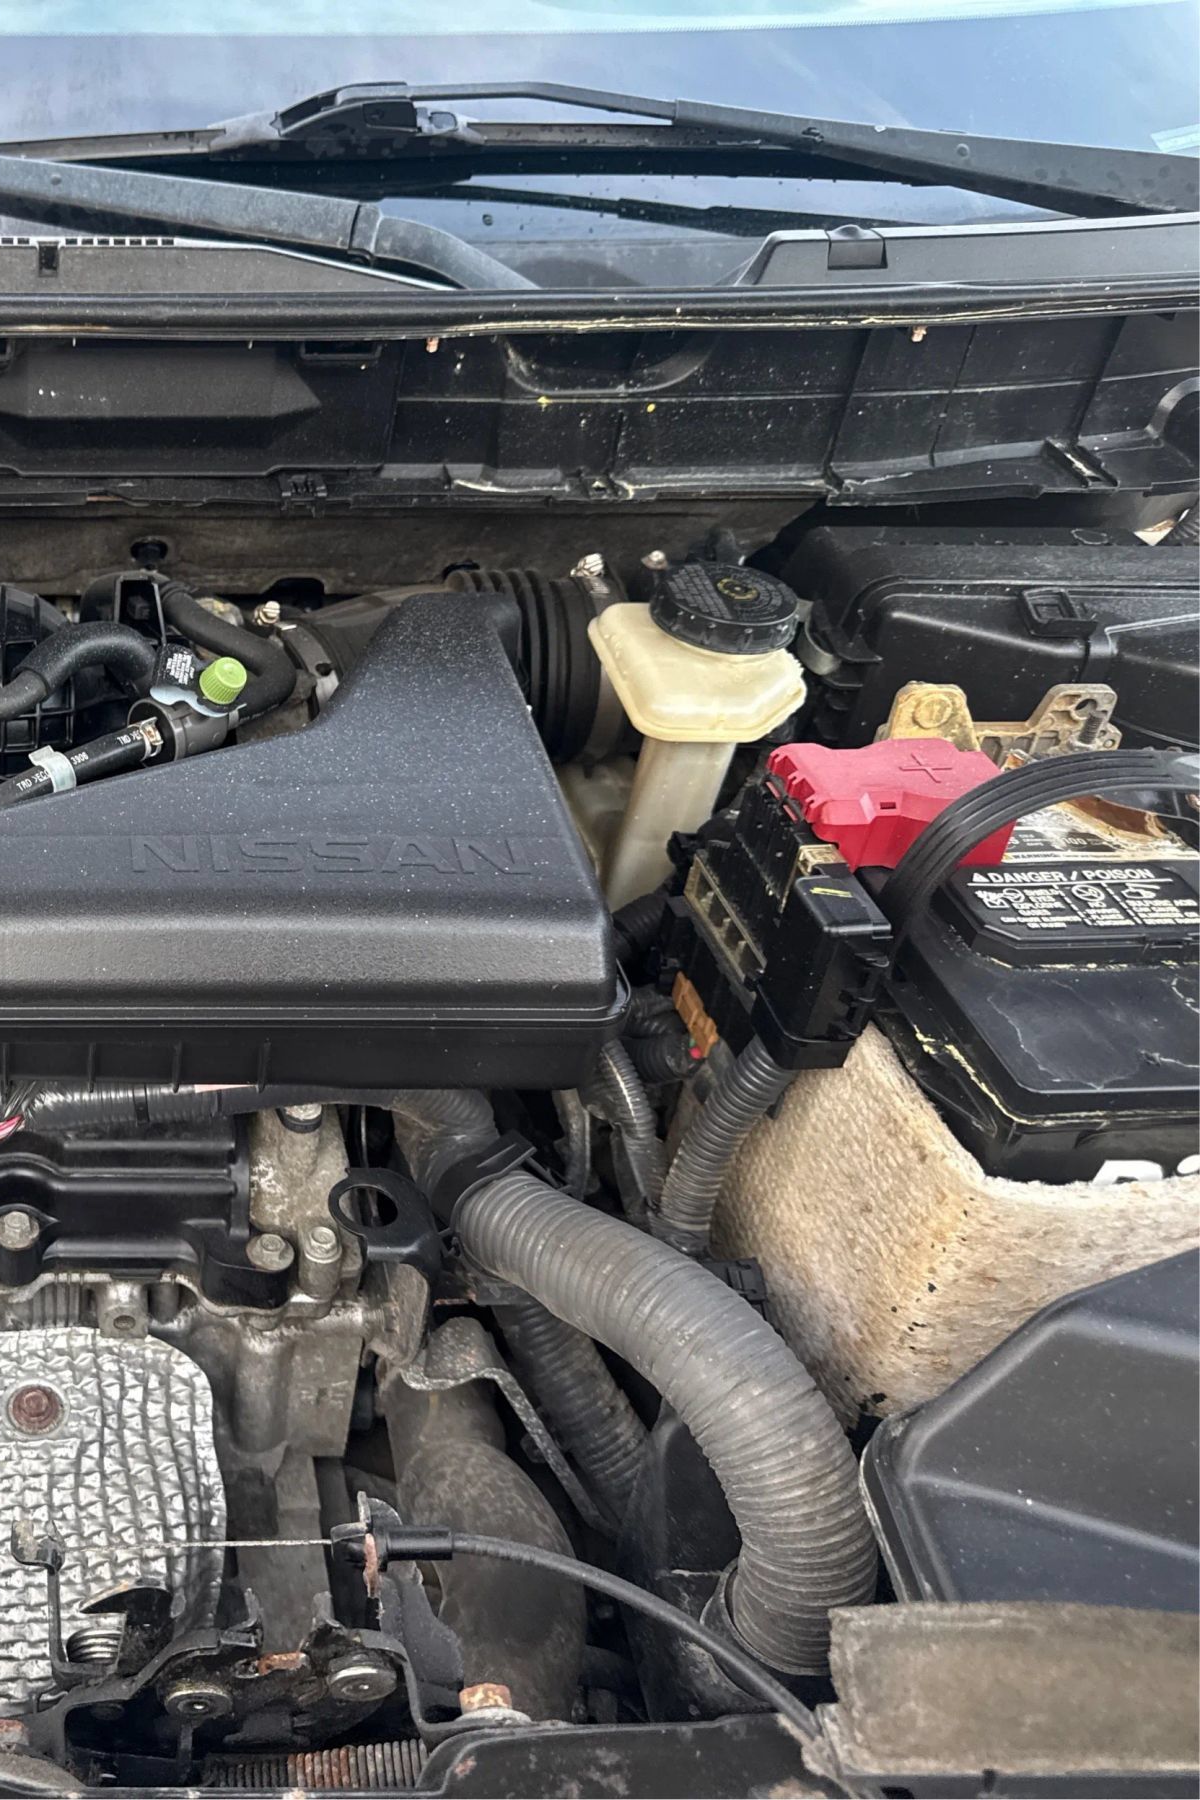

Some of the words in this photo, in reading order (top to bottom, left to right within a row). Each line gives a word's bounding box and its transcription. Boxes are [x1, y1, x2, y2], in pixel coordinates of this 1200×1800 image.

[16, 778, 33, 792] TRD
[130, 834, 533, 876] NISSAN
[987, 871, 1067, 883] DANGER
[1081, 868, 1156, 881] POISON
